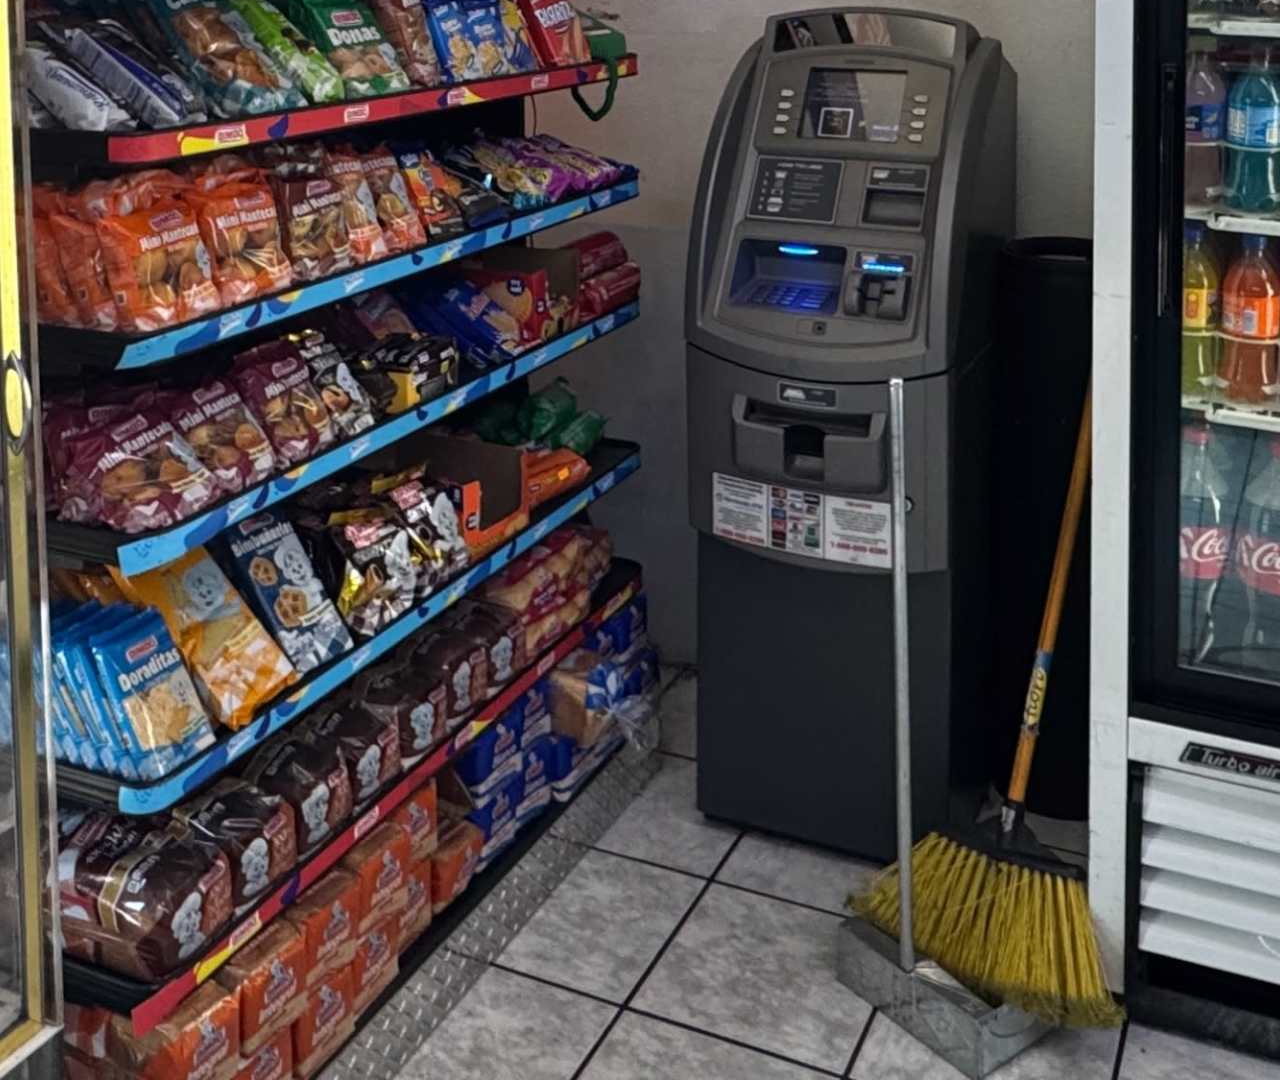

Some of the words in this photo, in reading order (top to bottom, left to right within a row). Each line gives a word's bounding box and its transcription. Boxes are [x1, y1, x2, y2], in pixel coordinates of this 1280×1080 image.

[327, 26, 382, 47] Donas
[118, 648, 180, 692] Doraditas
[1202, 747, 1251, 772] Turbo
